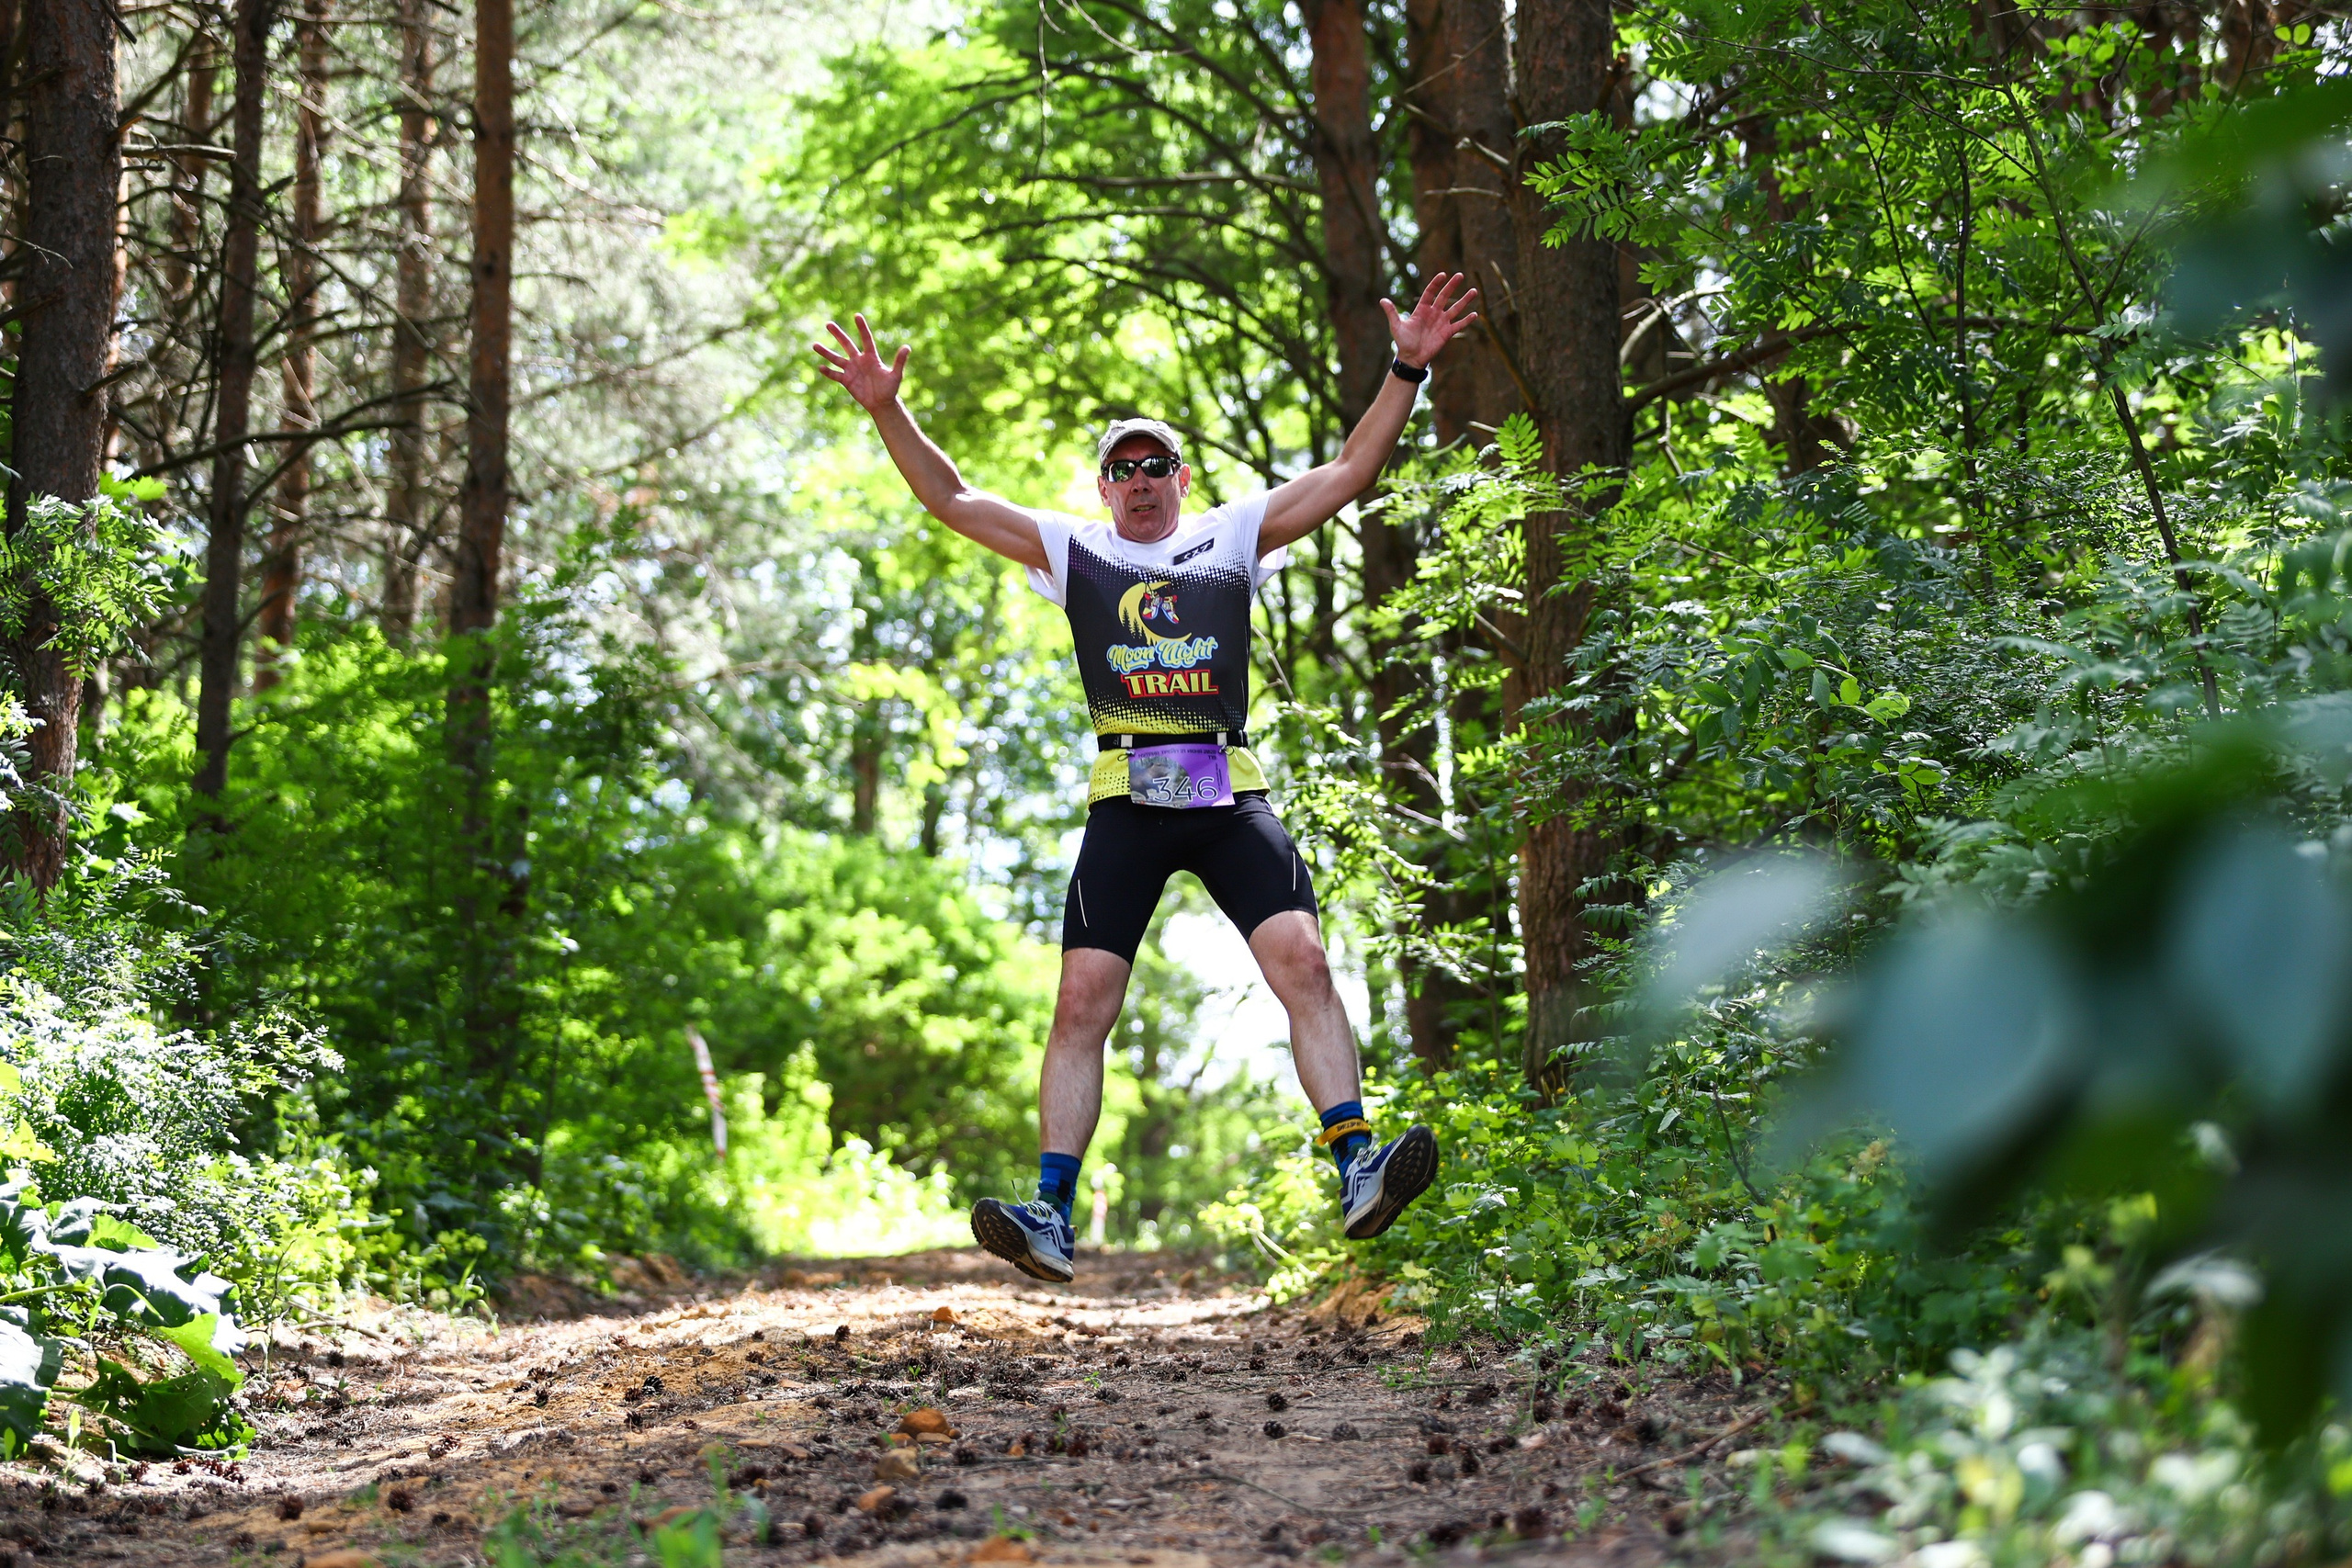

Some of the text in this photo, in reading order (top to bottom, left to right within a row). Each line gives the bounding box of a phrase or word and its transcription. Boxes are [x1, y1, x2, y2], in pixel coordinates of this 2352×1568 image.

[1107, 636, 1218, 673] Moon Night
[1122, 671, 1218, 696] TRAIL
[1152, 776, 1218, 804] 346
